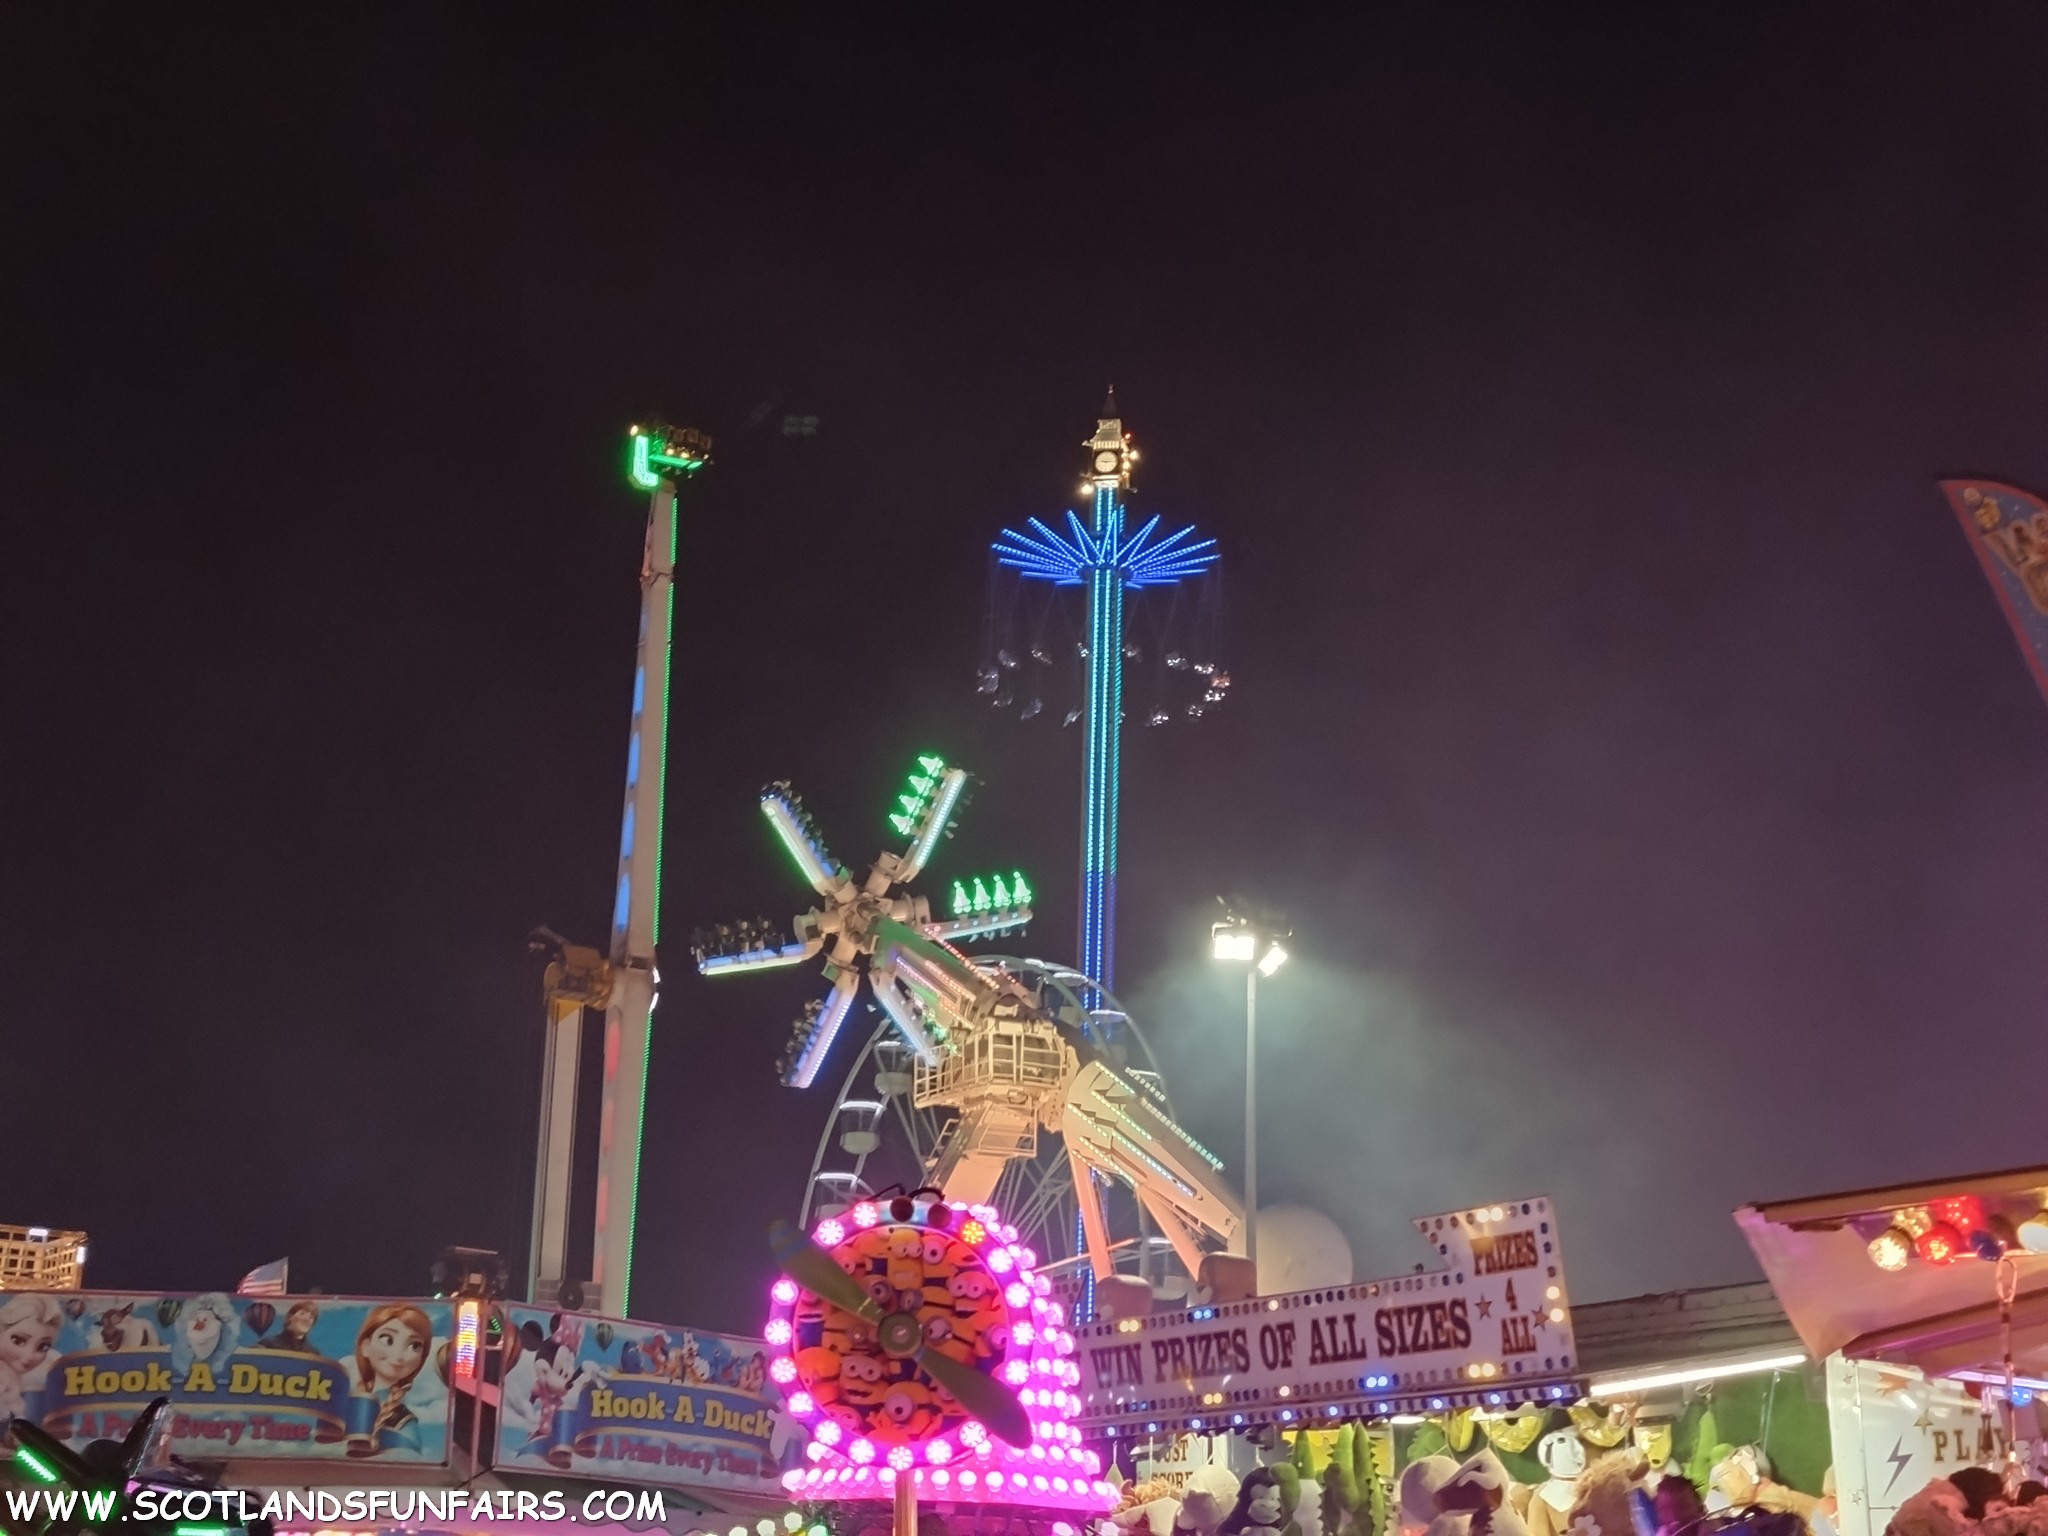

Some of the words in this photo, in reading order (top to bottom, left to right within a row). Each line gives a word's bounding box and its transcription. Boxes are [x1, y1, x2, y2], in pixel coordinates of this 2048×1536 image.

[1470, 1229, 1539, 1276] PRIZES
[1504, 1277, 1518, 1312] 4
[1090, 1343, 1144, 1390] WIN
[1151, 1328, 1251, 1383] PRIZES
[1259, 1321, 1297, 1371] OF
[1309, 1313, 1367, 1365] ALL
[1374, 1297, 1473, 1357] SIZES
[1501, 1315, 1537, 1356] ALL
[79, 1413, 98, 1438] A
[172, 1416, 247, 1445] Every
[252, 1416, 311, 1441] Time
